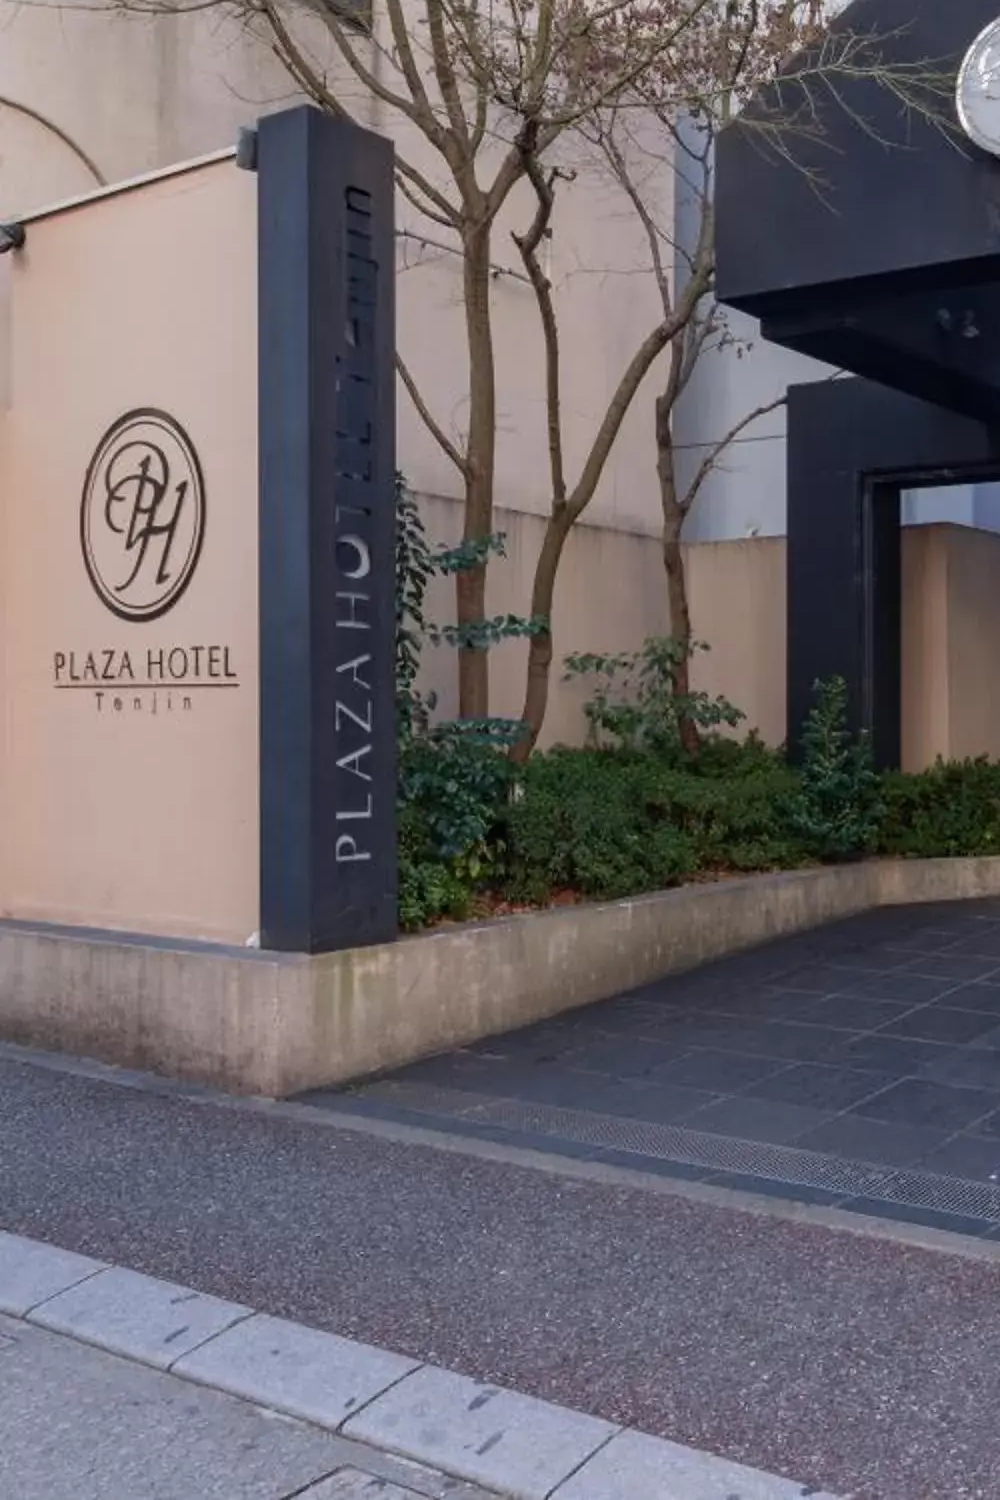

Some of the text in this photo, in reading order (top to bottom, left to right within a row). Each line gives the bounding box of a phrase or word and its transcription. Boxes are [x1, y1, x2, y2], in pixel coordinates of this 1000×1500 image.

[335, 421, 372, 629] HOTEL
[54, 646, 237, 681] PLAZA HOTEL
[95, 692, 192, 714] Tenjin
[335, 652, 372, 862] PLAZA
